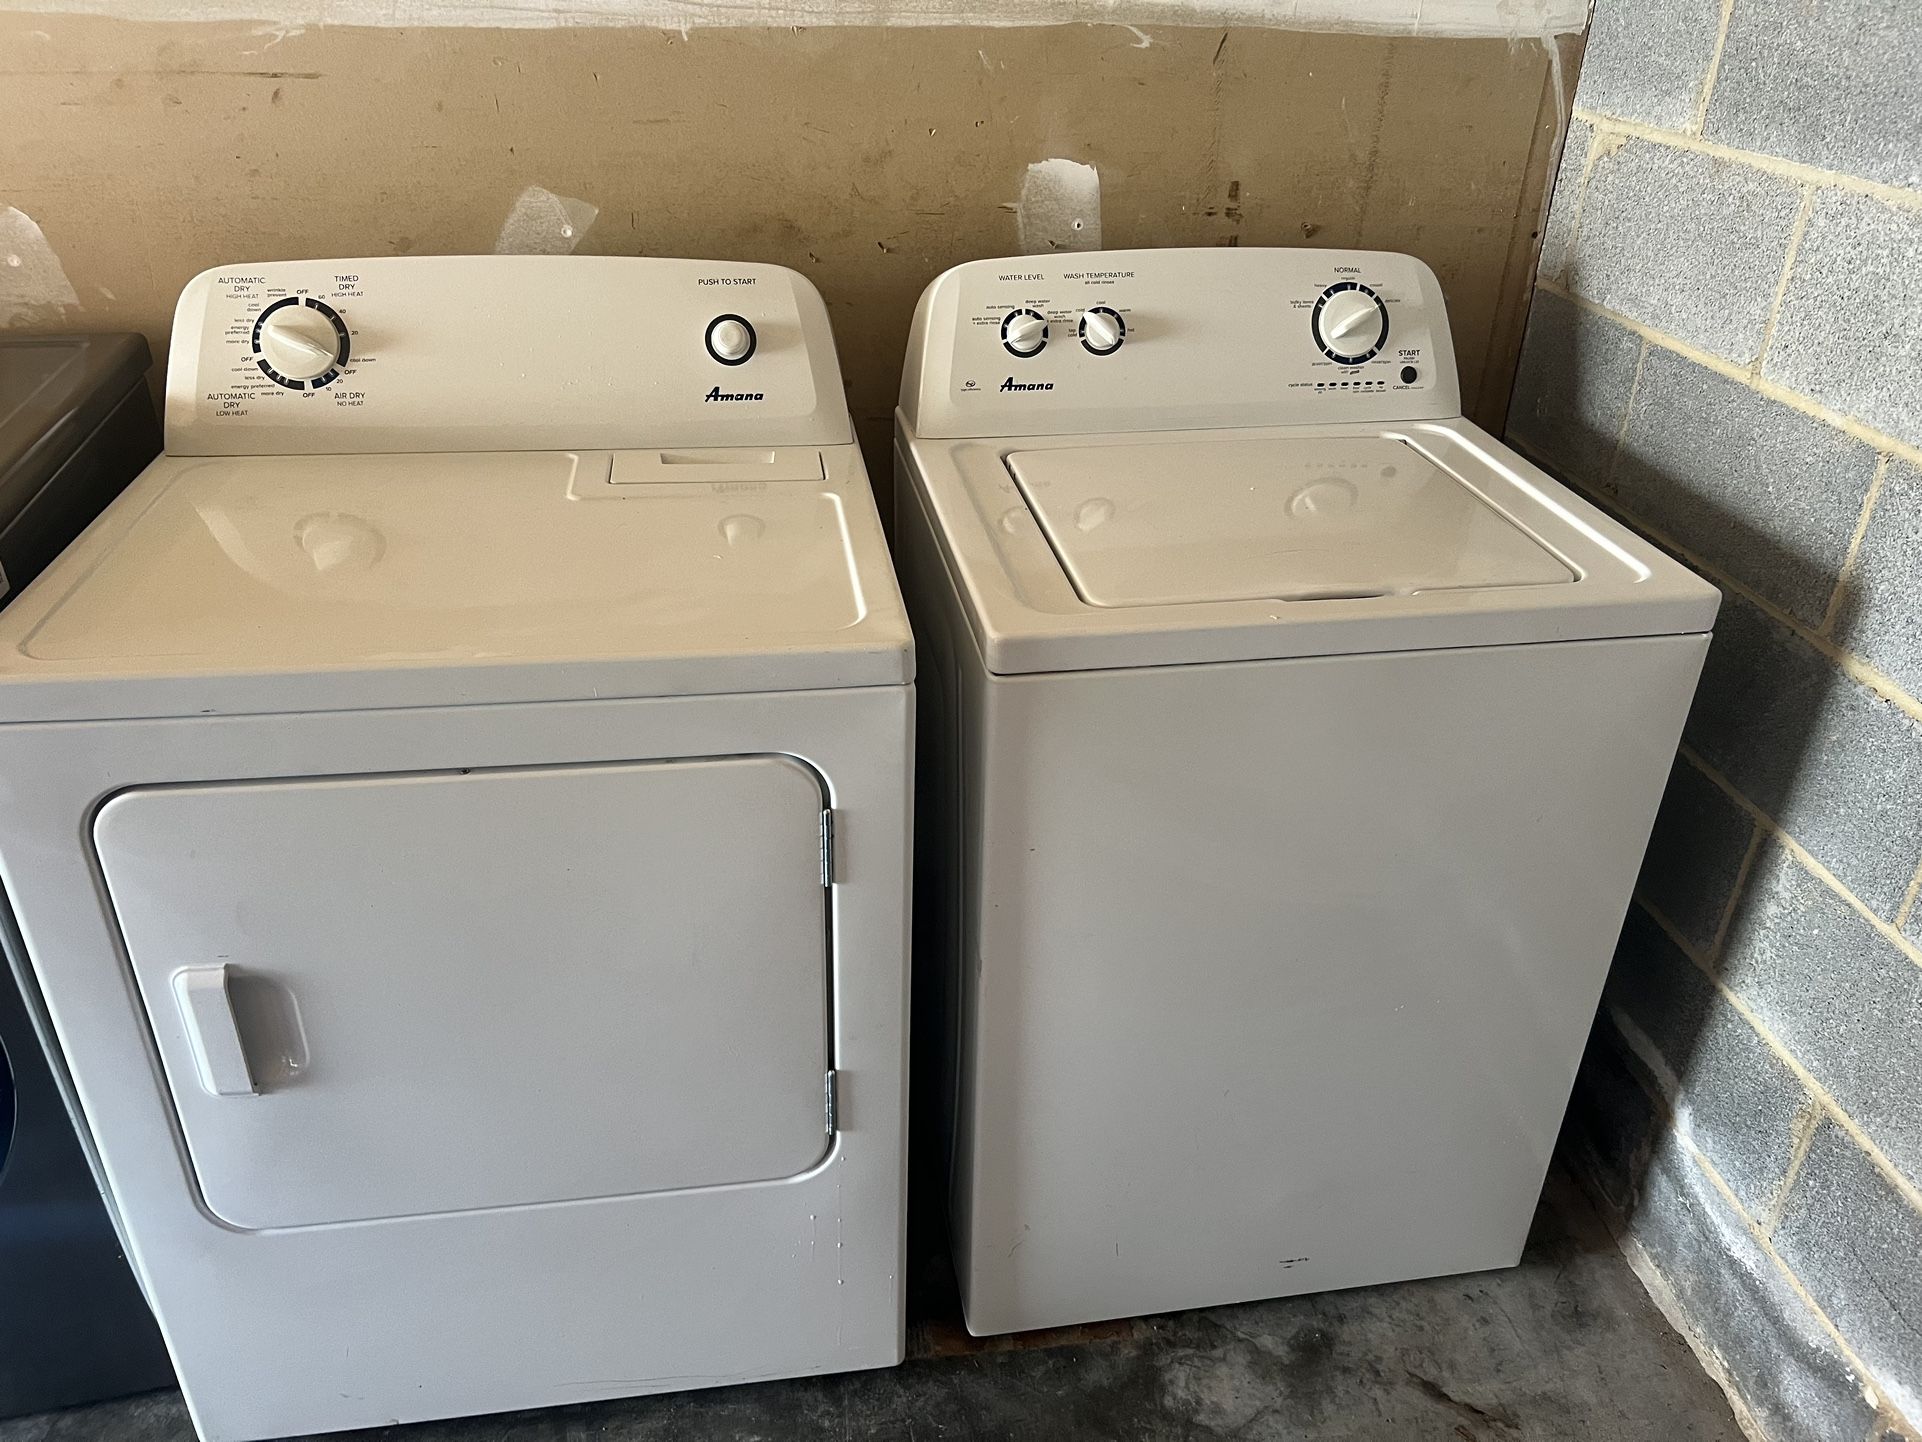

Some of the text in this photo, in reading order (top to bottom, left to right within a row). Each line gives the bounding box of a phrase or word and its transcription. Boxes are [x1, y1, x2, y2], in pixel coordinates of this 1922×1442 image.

[1086, 271, 1135, 279] TEMPERATURE
[1000, 376, 1054, 393] Amana
[207, 392, 256, 400] AUTOMATIC
[704, 386, 764, 403] Amana
[223, 401, 240, 409] DRY
